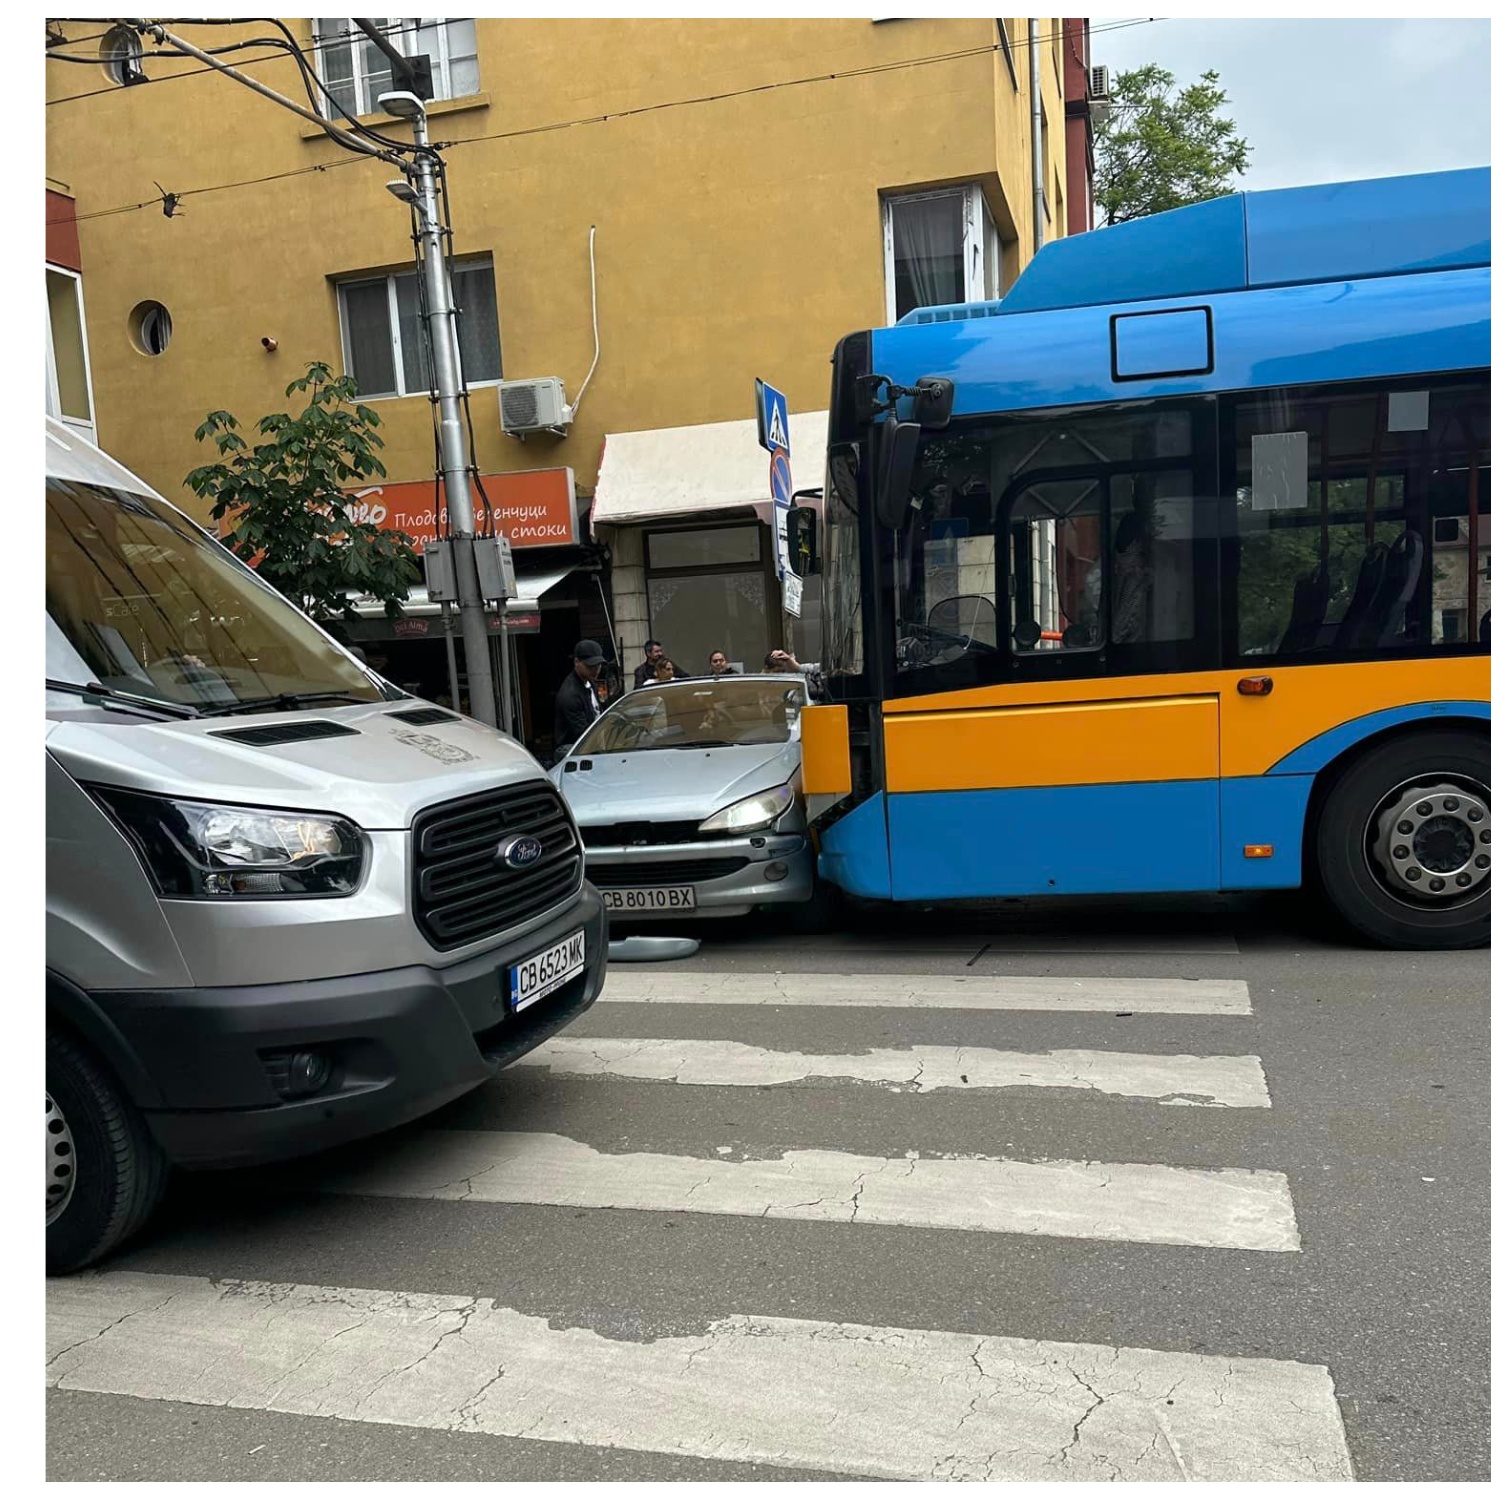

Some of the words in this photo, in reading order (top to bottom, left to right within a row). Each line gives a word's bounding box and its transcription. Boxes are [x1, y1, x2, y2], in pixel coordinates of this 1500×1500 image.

[511, 527, 567, 540] стоки
[517, 843, 536, 859] Ford
[626, 890, 665, 907] 8010
[539, 945, 567, 983] 6523
